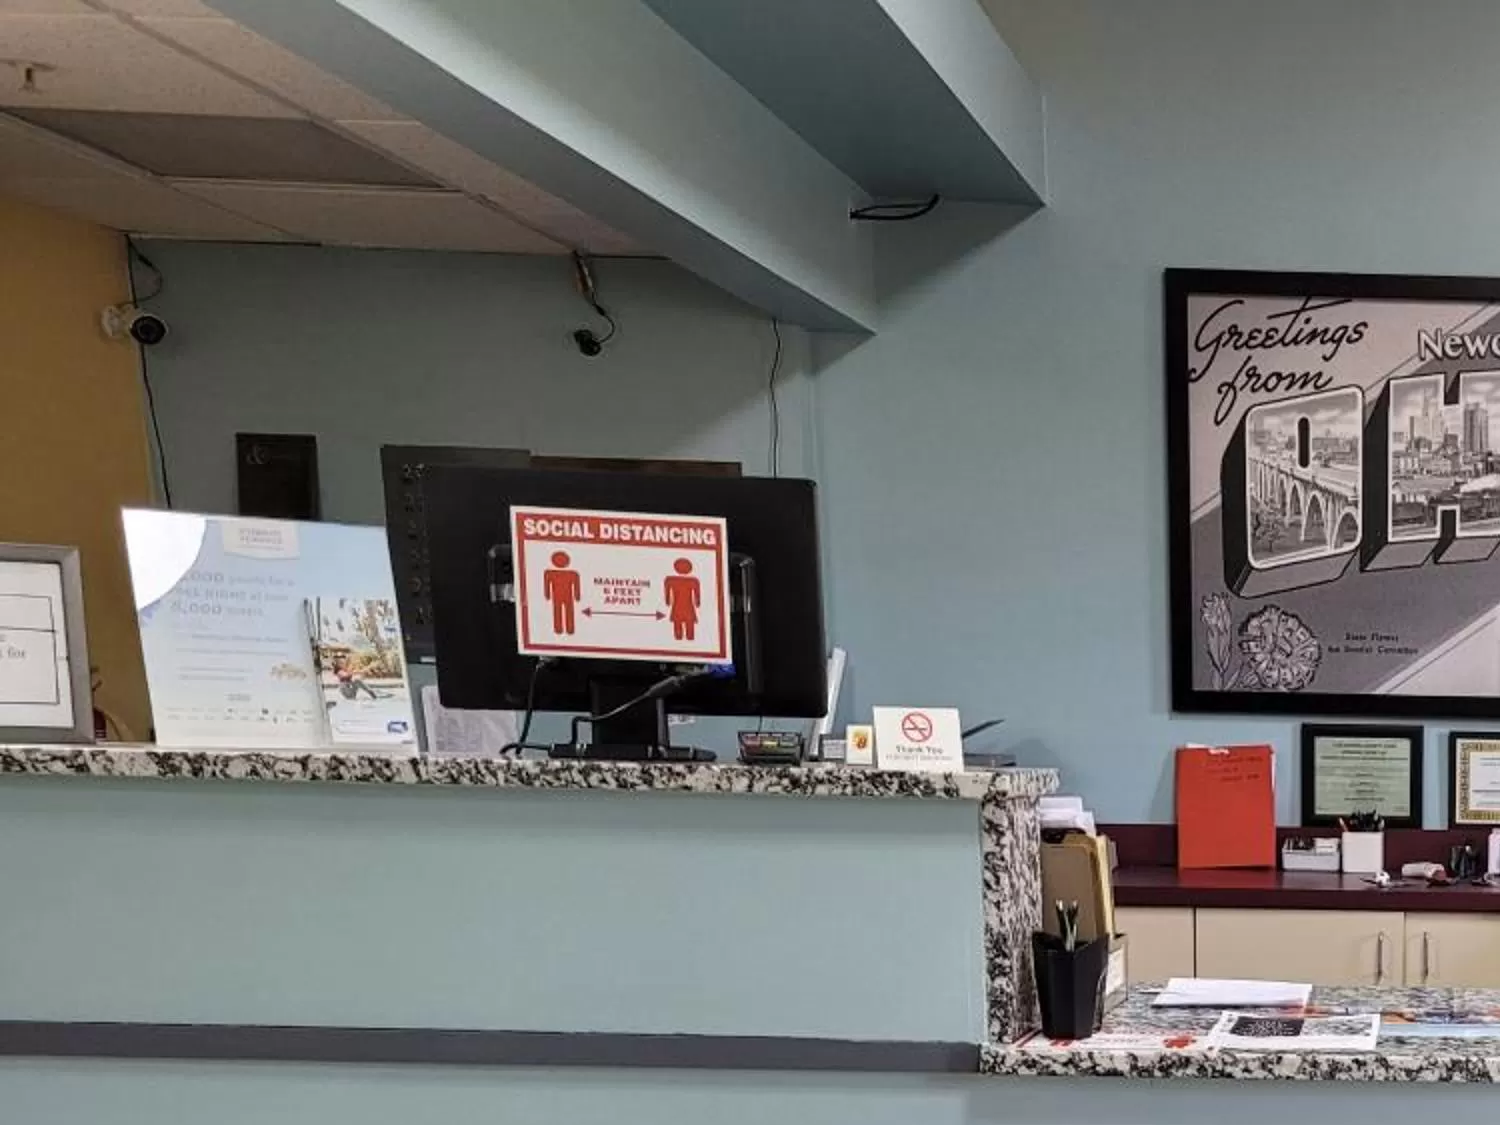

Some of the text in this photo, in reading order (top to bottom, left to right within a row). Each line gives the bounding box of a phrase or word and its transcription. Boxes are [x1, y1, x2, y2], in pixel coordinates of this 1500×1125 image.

[1187, 296, 1368, 382] Greetings
[1214, 355, 1333, 426] from
[524, 519, 717, 545] SOCIAL DISTANCING
[593, 577, 651, 588] MAINTAIN
[603, 596, 641, 605] APART
[613, 588, 641, 596] FEET
